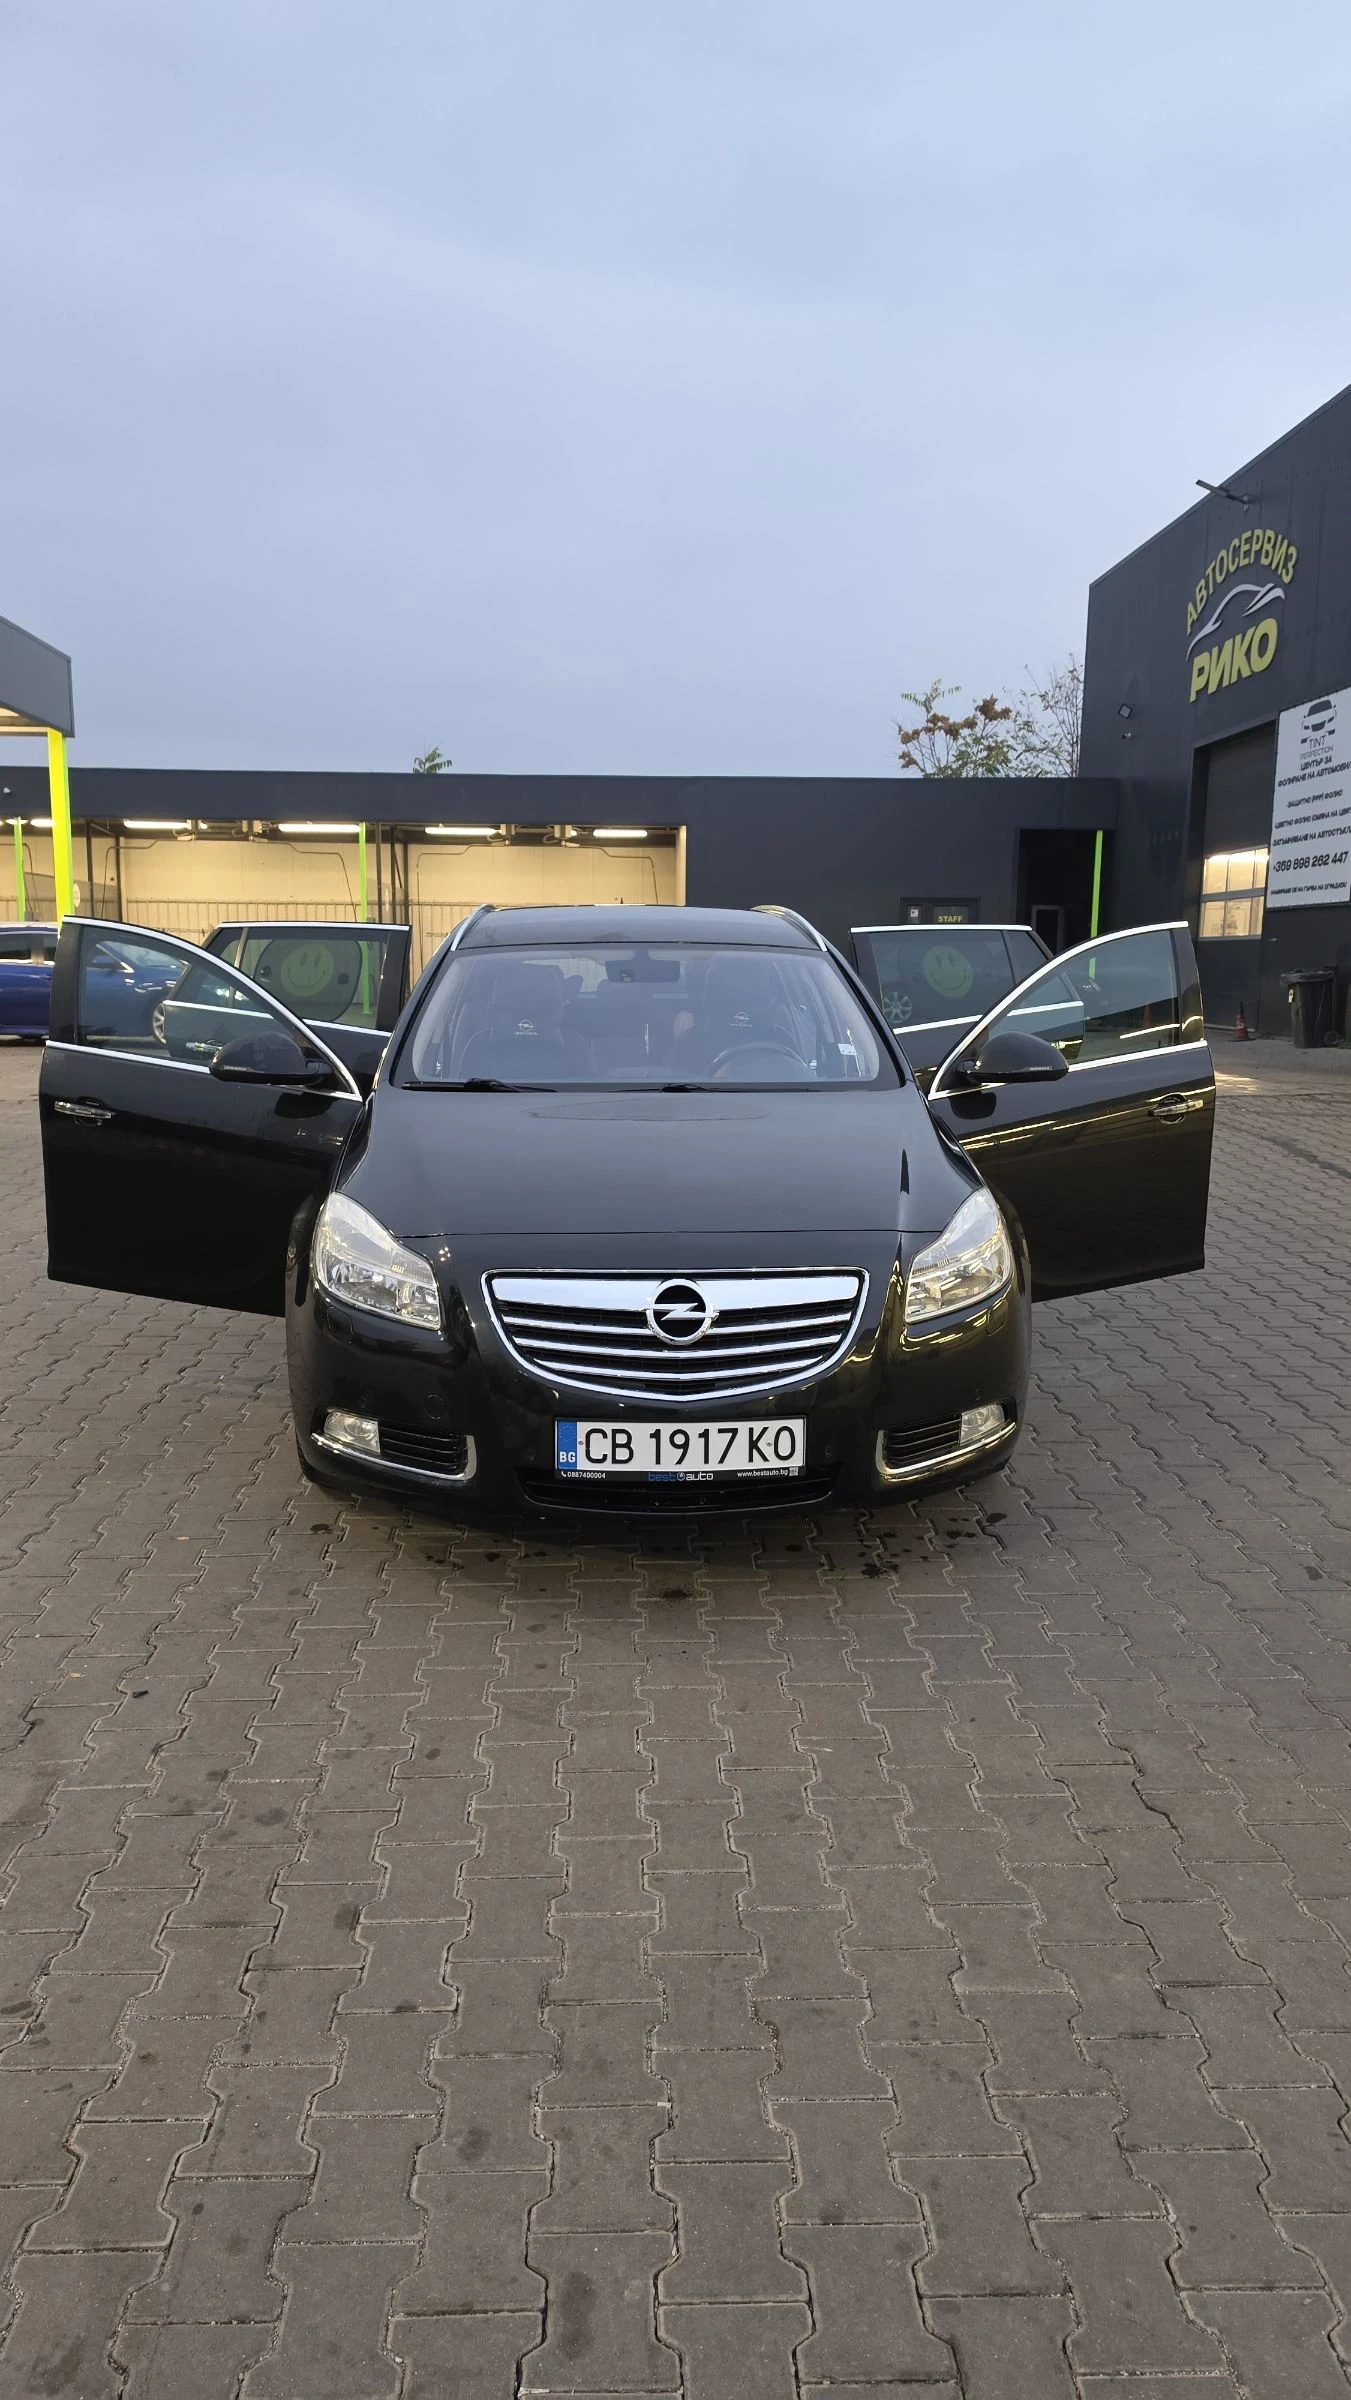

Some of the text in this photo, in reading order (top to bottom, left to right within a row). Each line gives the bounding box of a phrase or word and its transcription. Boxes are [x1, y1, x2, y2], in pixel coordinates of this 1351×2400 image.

[1186, 528, 1298, 636] АВТОСЕРВИЗ
[1189, 617, 1279, 703] РИКО
[1308, 735, 1326, 750] TINT
[1293, 856, 1311, 871] 898
[1331, 850, 1349, 864] 447
[938, 915, 963, 923] STAFF
[559, 1451, 576, 1463] BG
